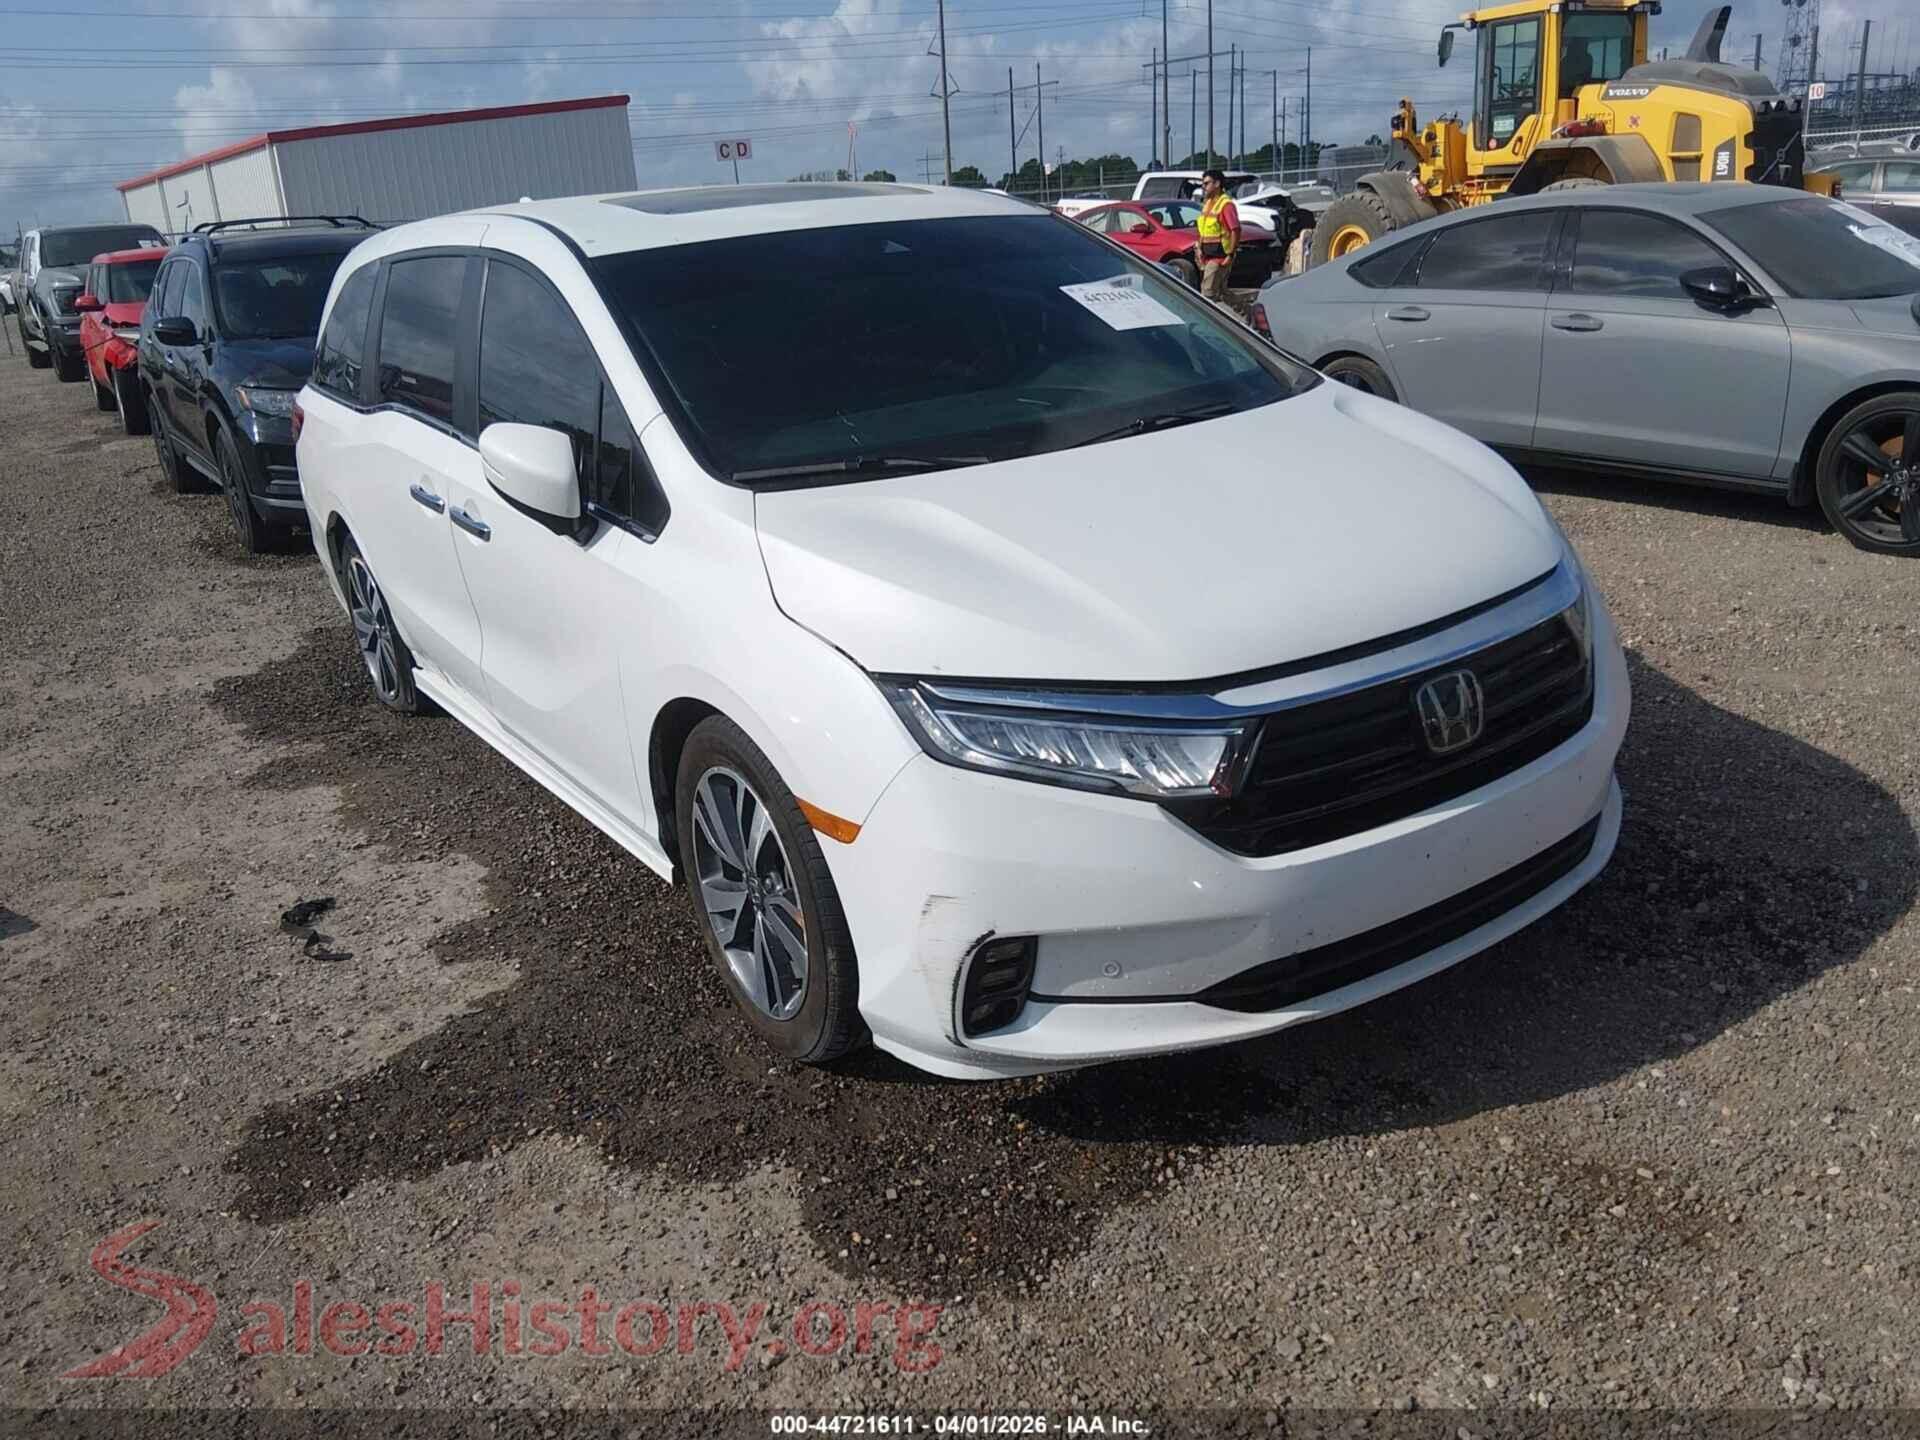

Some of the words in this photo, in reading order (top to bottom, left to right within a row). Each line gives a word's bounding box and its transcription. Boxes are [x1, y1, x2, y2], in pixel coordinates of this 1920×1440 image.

[1607, 87, 1650, 97] VOLVO
[1811, 85, 1824, 97] 10
[719, 143, 730, 159] C
[736, 142, 748, 157] D
[1715, 151, 1730, 175] L90H
